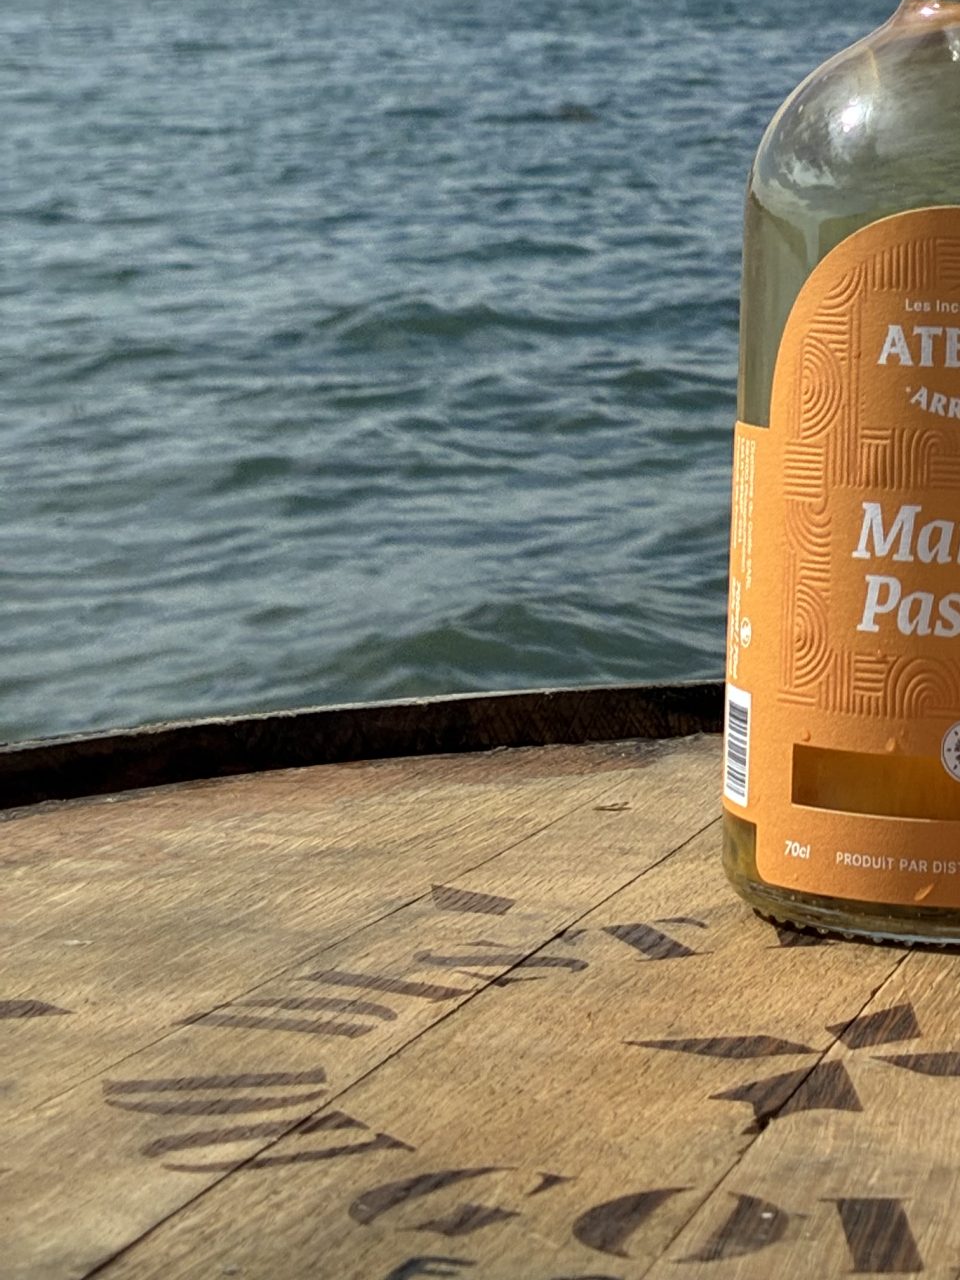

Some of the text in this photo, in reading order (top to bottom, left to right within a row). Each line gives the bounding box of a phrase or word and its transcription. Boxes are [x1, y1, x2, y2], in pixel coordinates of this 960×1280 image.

[905, 298, 931, 312] Les
[784, 840, 811, 859] 70cl
[836, 851, 894, 870] PRODUIT
[899, 858, 928, 873] PAR
